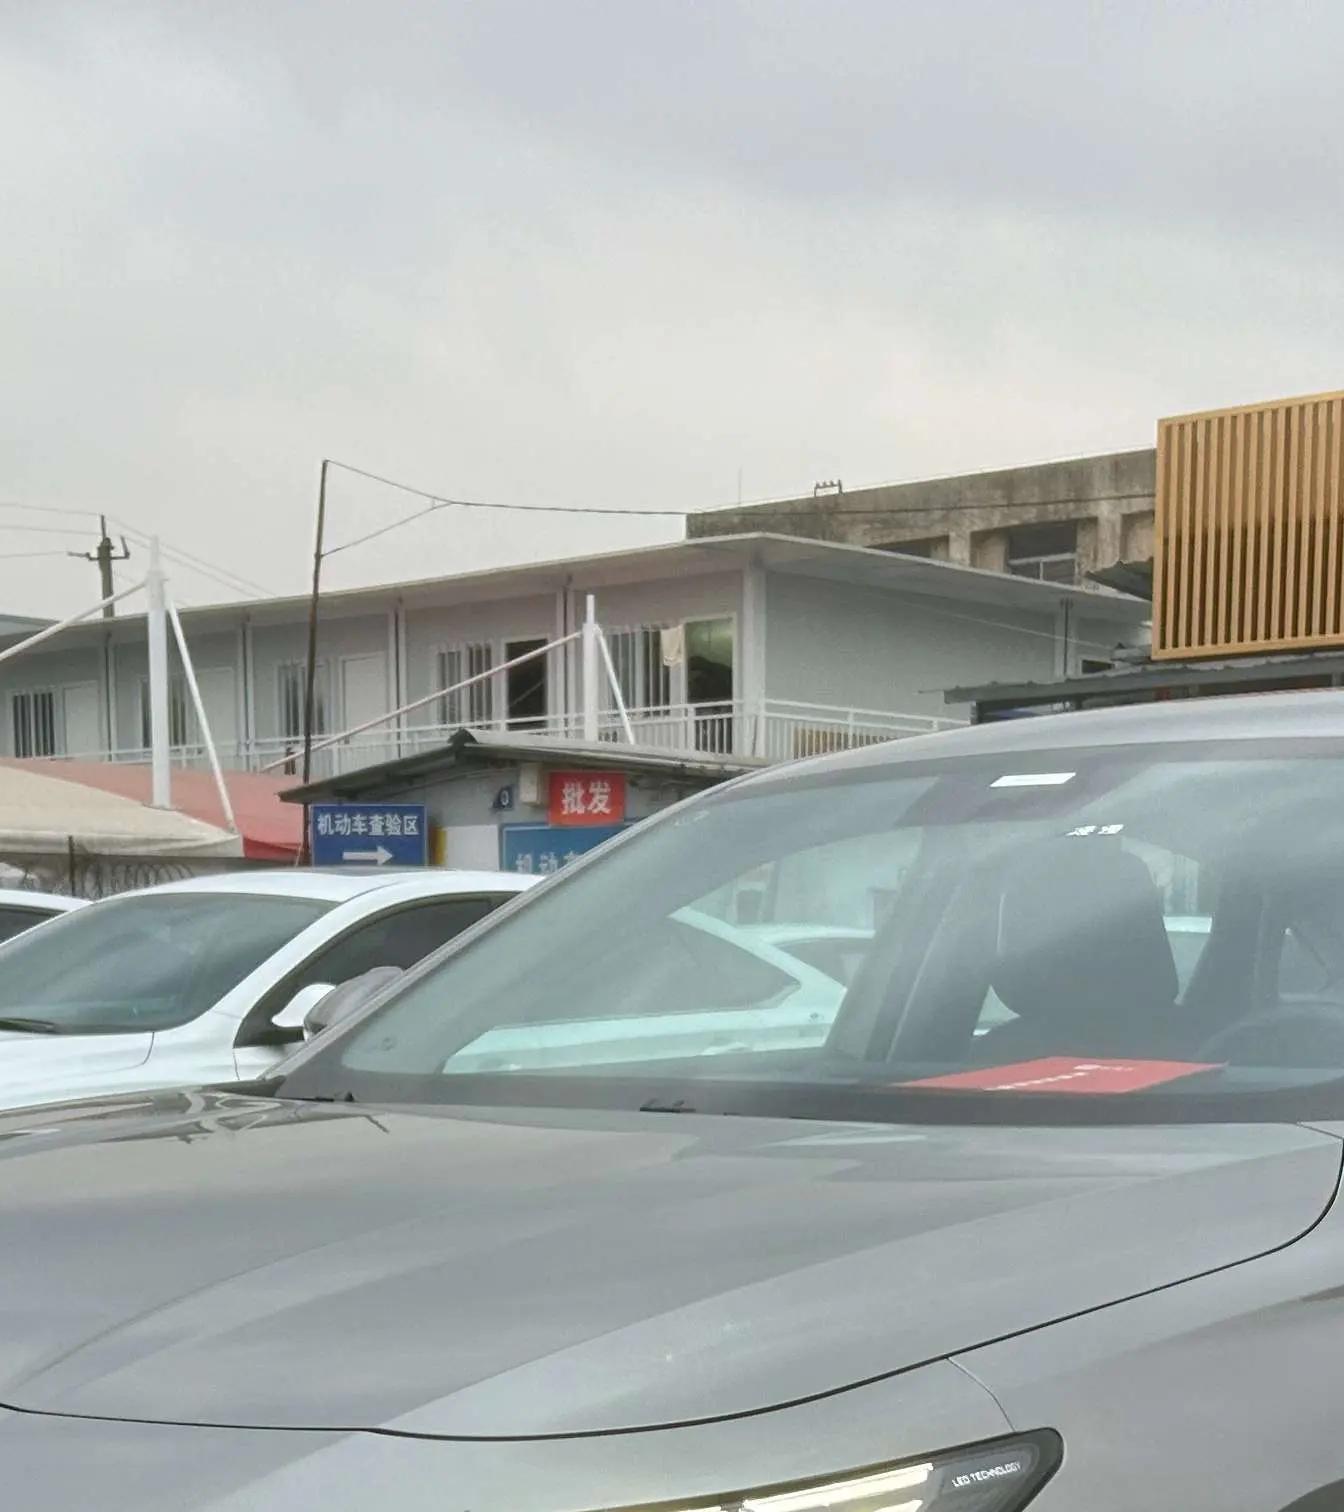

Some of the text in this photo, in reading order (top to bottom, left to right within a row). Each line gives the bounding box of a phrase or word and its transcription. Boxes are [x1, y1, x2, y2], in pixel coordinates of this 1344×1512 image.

[561, 781, 612, 815] 批发
[317, 814, 419, 837] 机动车查验区
